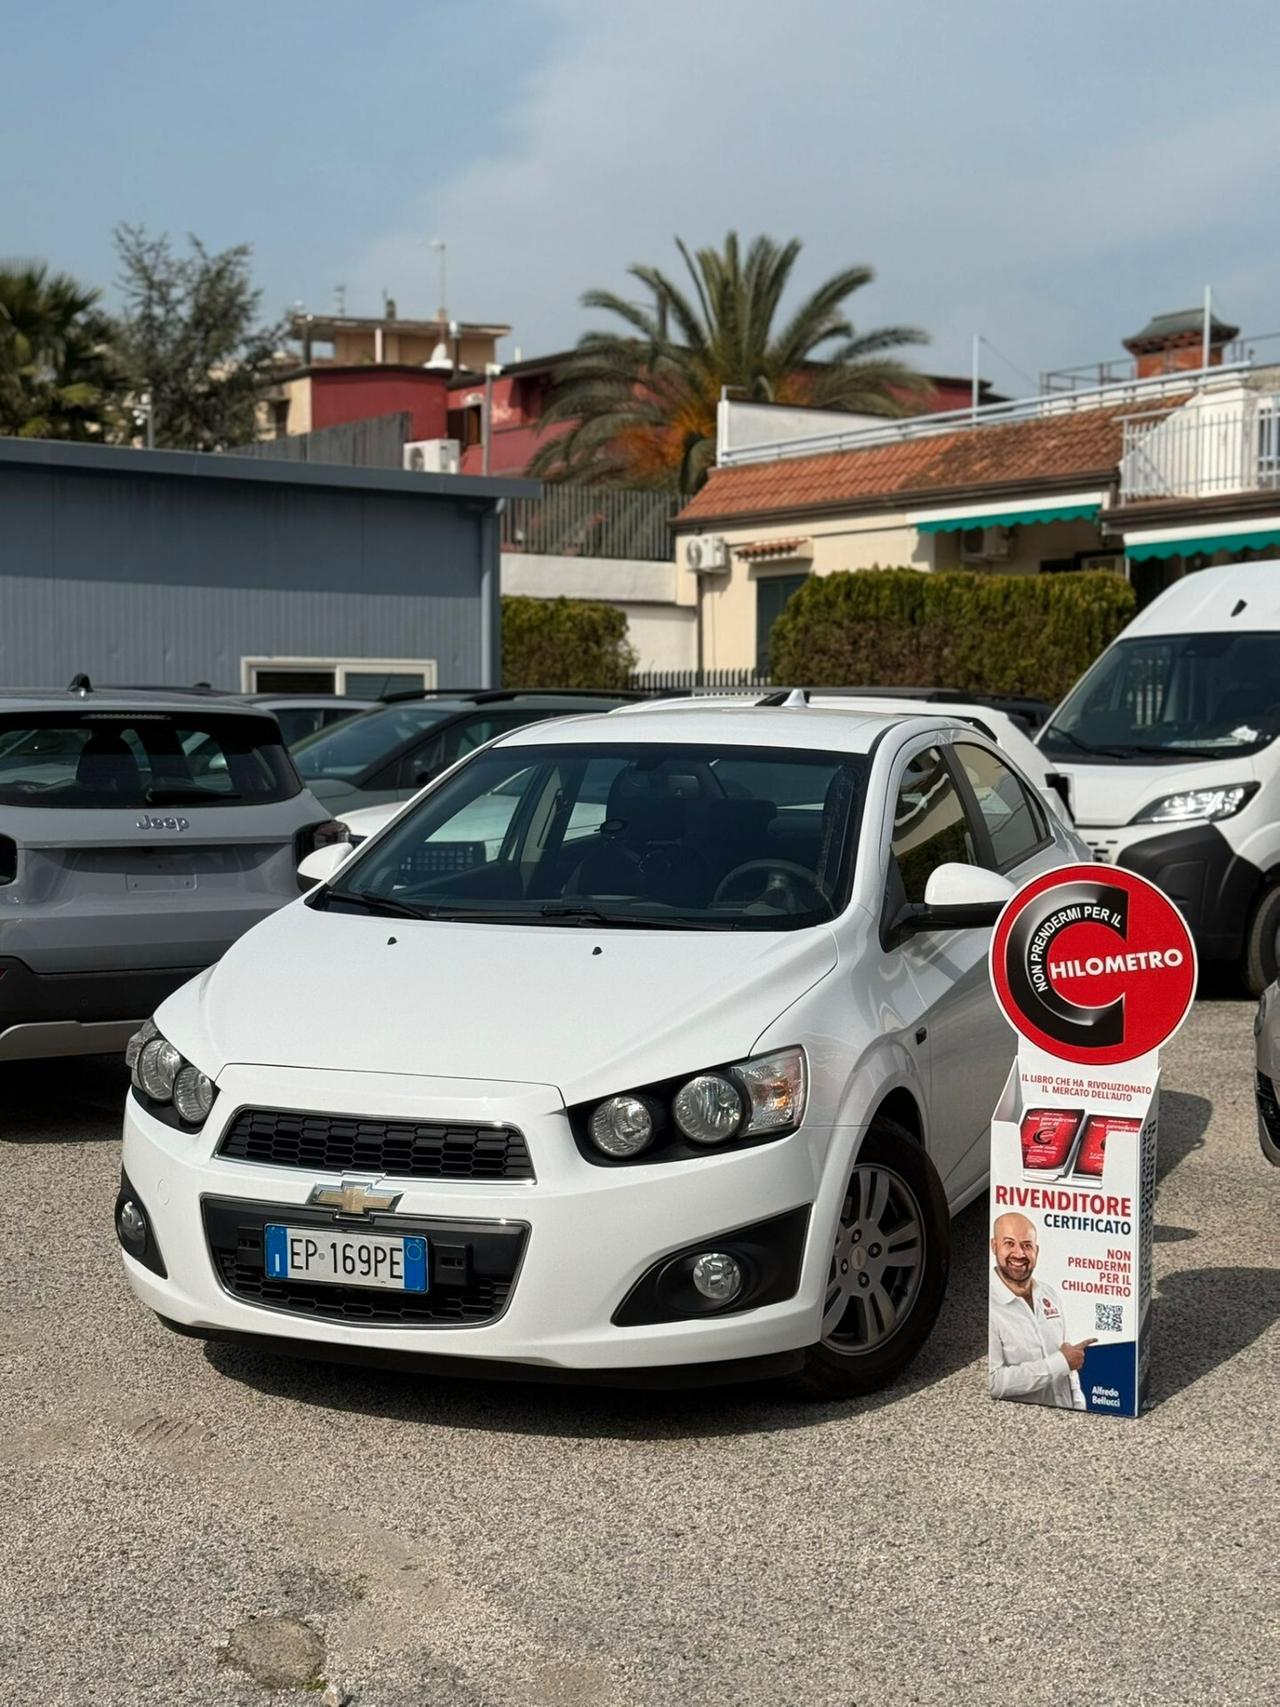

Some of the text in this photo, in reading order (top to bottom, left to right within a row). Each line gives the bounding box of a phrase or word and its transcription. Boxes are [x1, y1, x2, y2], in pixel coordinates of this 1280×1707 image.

[136, 814, 190, 832] Jeep
[1031, 906, 1122, 993] NON PRENDERMI PER IL
[1022, 1074, 1152, 1094] IL LIBRO CHE HA RIVOLUZIONATO
[1042, 1085, 1133, 1102] IL MERCATO DELL'AUTO
[995, 1185, 1131, 1217] RIVENDITORE
[1044, 1213, 1131, 1235] CERTIFICATO
[1107, 1249, 1131, 1261] NON
[1068, 1257, 1131, 1273] PRENDERMI
[1099, 1271, 1131, 1285] PER IL
[1062, 1280, 1131, 1297] CHILOMETRO
[1092, 1386, 1119, 1397] Alfredo
[1092, 1395, 1120, 1407] Bellucci
